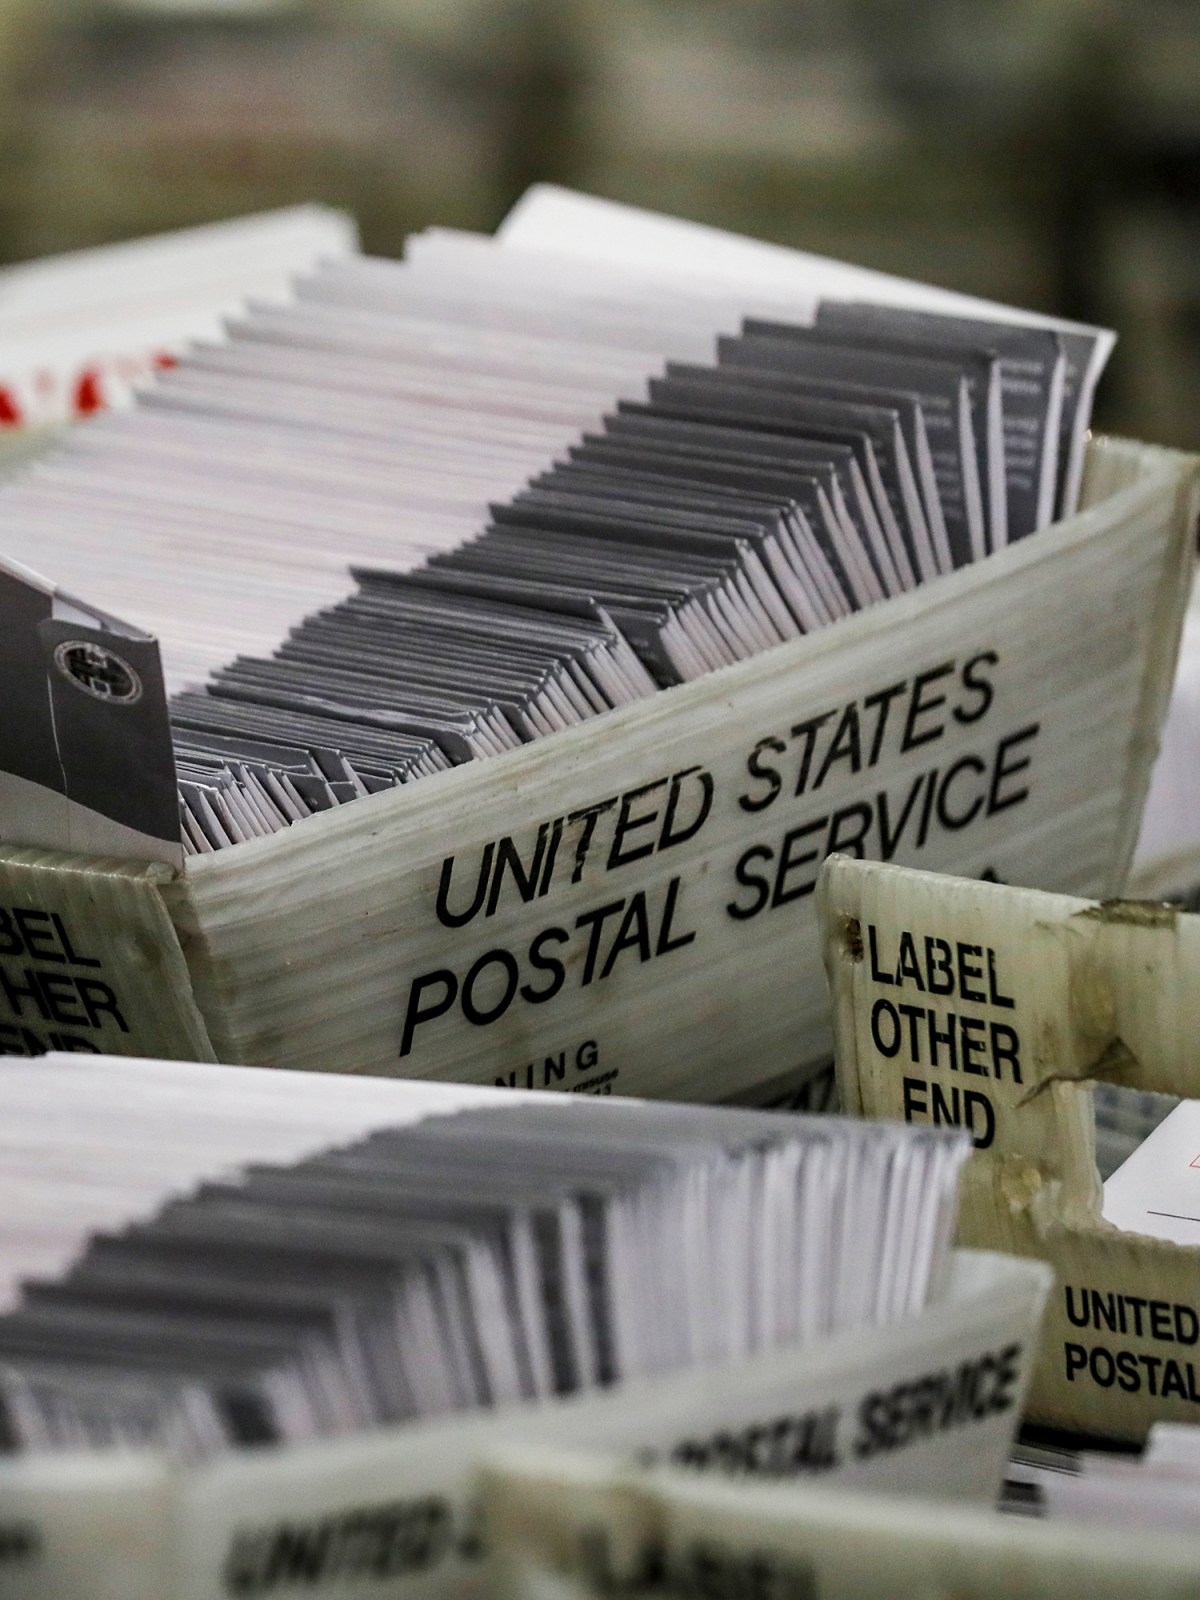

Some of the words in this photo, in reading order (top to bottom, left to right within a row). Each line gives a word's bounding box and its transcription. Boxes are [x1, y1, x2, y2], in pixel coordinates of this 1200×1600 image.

[435, 764, 715, 929] UNITED
[738, 650, 998, 813] STATES
[399, 876, 696, 1058] POSTAL
[726, 723, 1040, 921] SERVICE
[867, 924, 1016, 1010] LABEL
[870, 998, 1024, 1085] OTHER
[903, 1076, 996, 1150] END
[1065, 1285, 1200, 1346] UNITED
[1064, 1341, 1200, 1404] POSTAL
